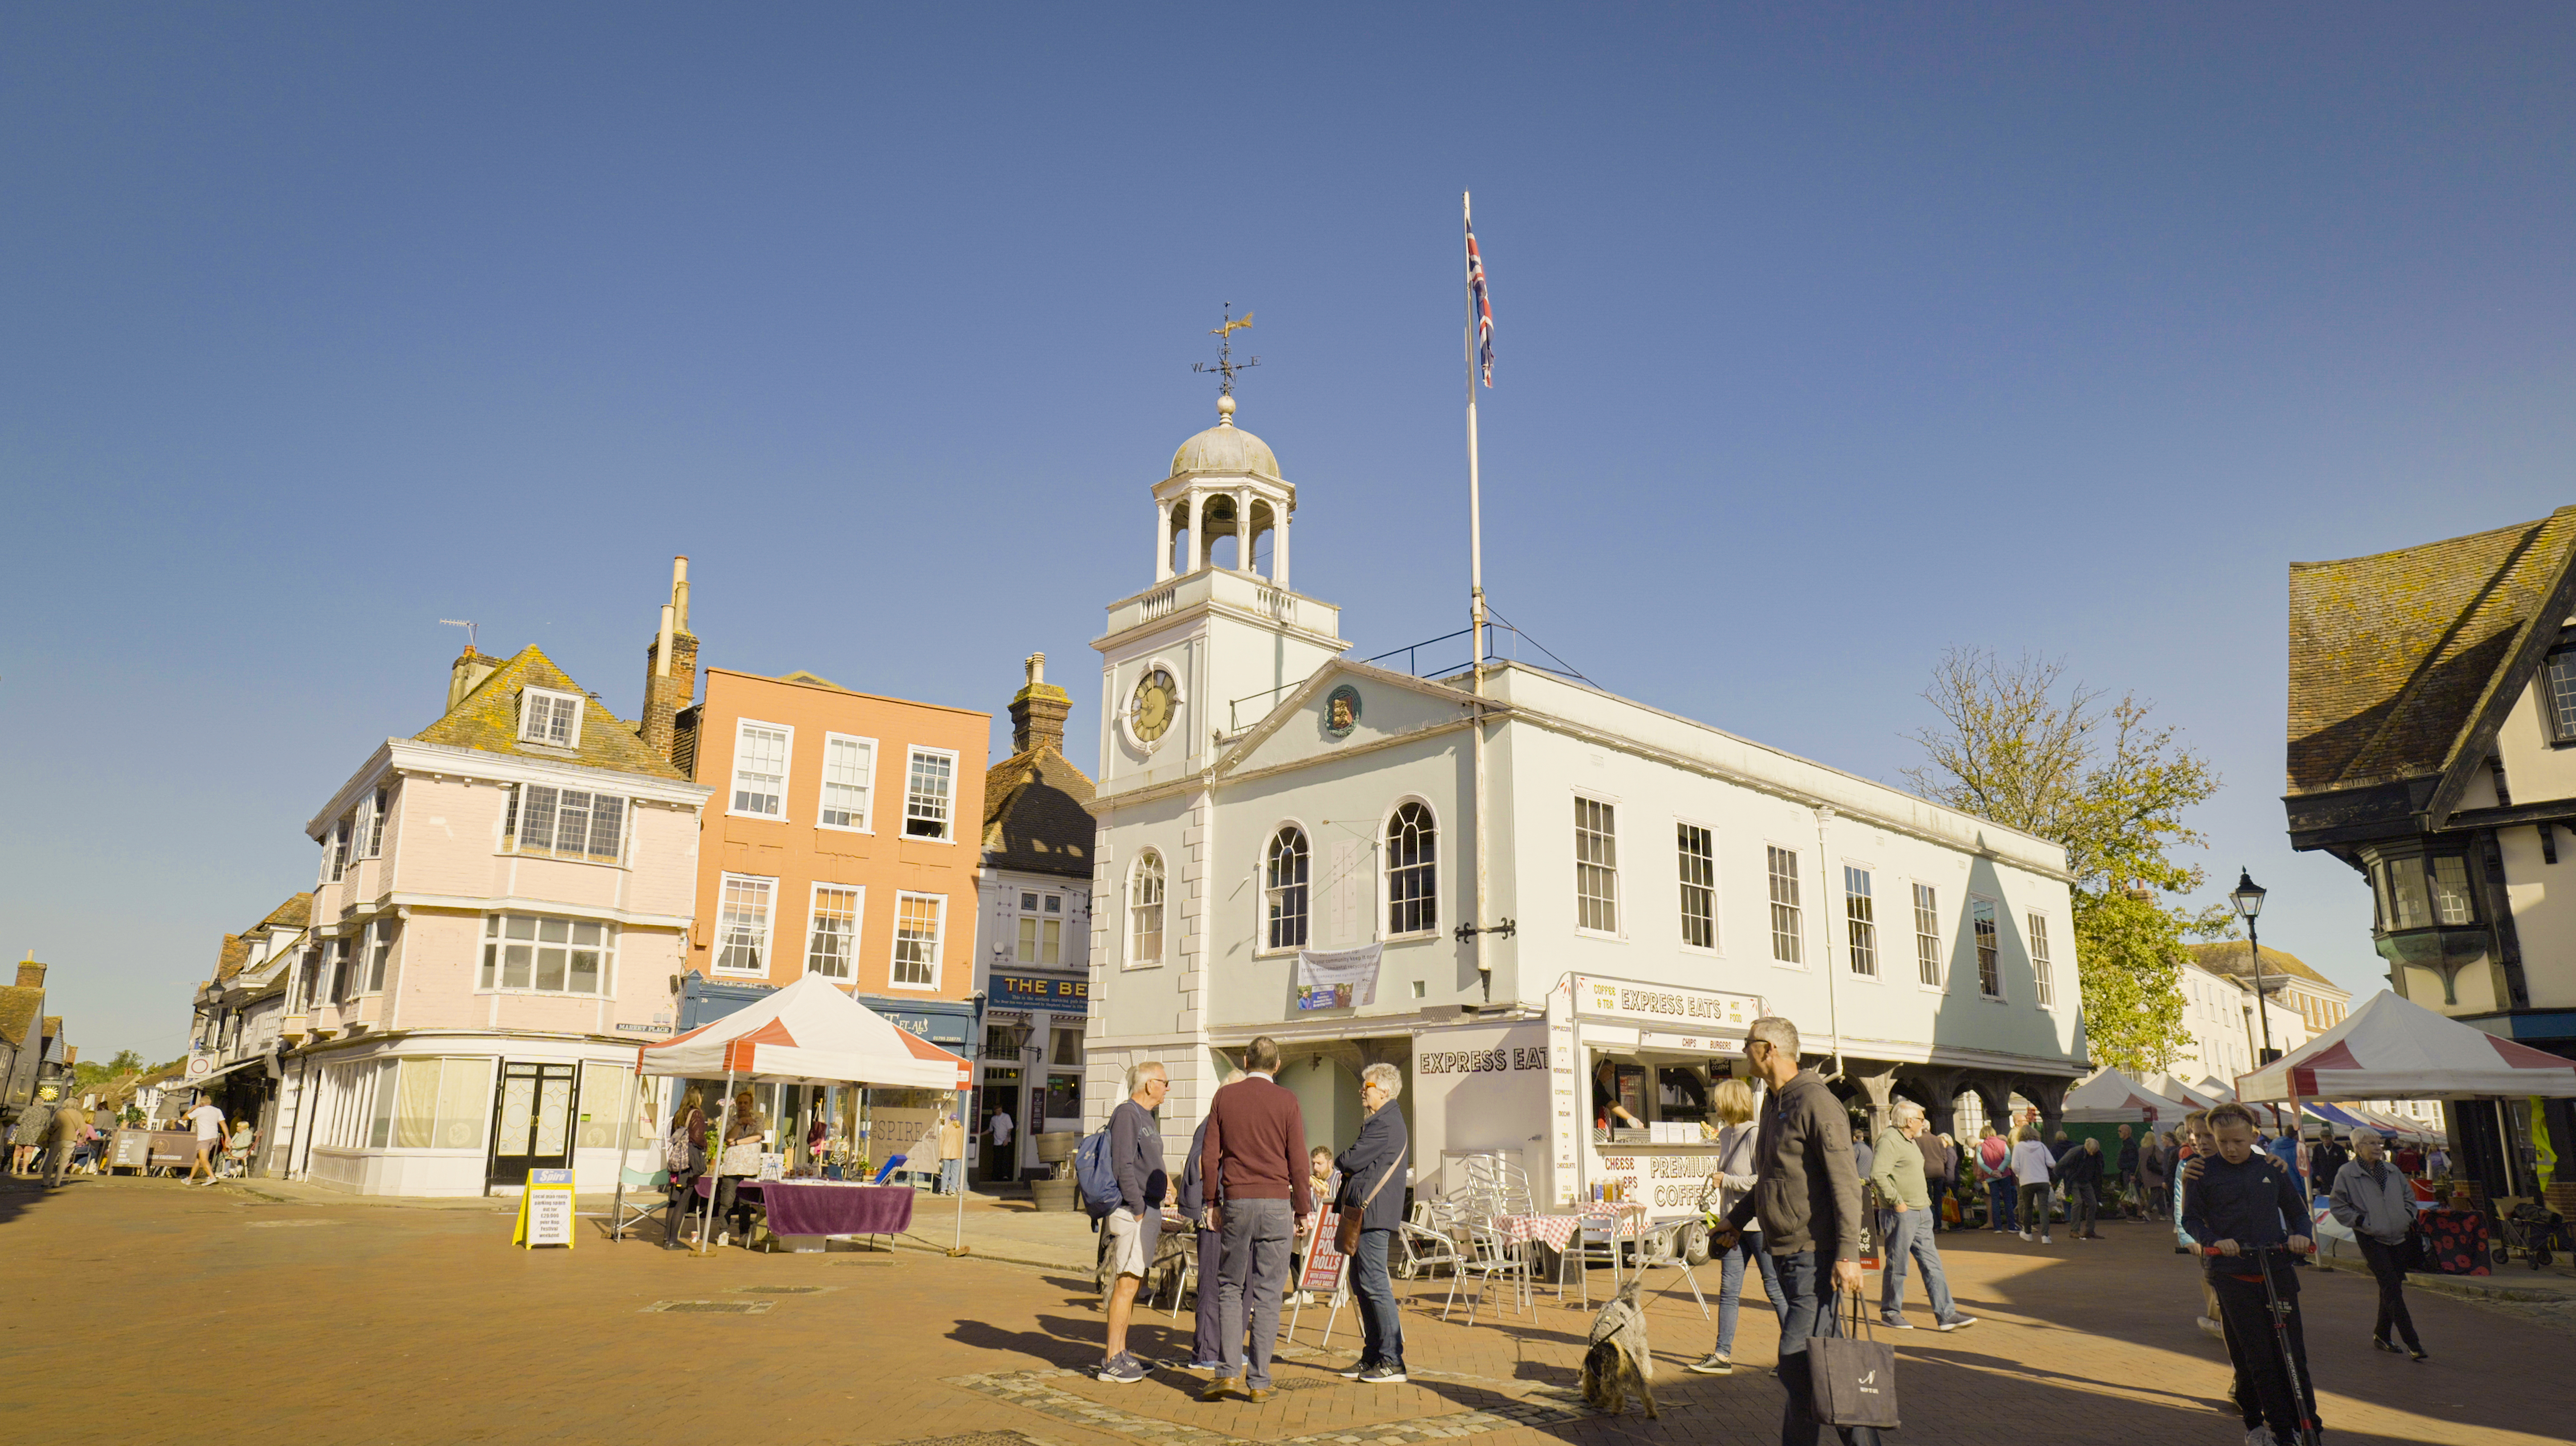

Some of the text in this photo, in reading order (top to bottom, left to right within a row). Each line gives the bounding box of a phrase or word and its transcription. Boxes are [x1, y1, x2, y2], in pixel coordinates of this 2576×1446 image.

[1316, 964, 1347, 972] environmental
[1004, 978, 1047, 994] THE
[1594, 984, 1616, 996] COFFEE
[1603, 999, 1614, 1010] TEA
[1622, 989, 1721, 1019] EXPRESS EATS
[1730, 1001, 1740, 1011] HOT
[1730, 1013, 1742, 1023] FOOD
[1682, 1038, 1731, 1050] CHIPS BURGERS
[1420, 1049, 1507, 1074] EXPRESS
[878, 1120, 923, 1142] SPIRE
[1605, 1157, 1634, 1170] CHEESE
[1650, 1157, 1718, 1179] PREMIUM
[539, 1170, 566, 1182] Spire
[1654, 1185, 1717, 1207] COFFEES
[1311, 1255, 1341, 1271] ROLLS
